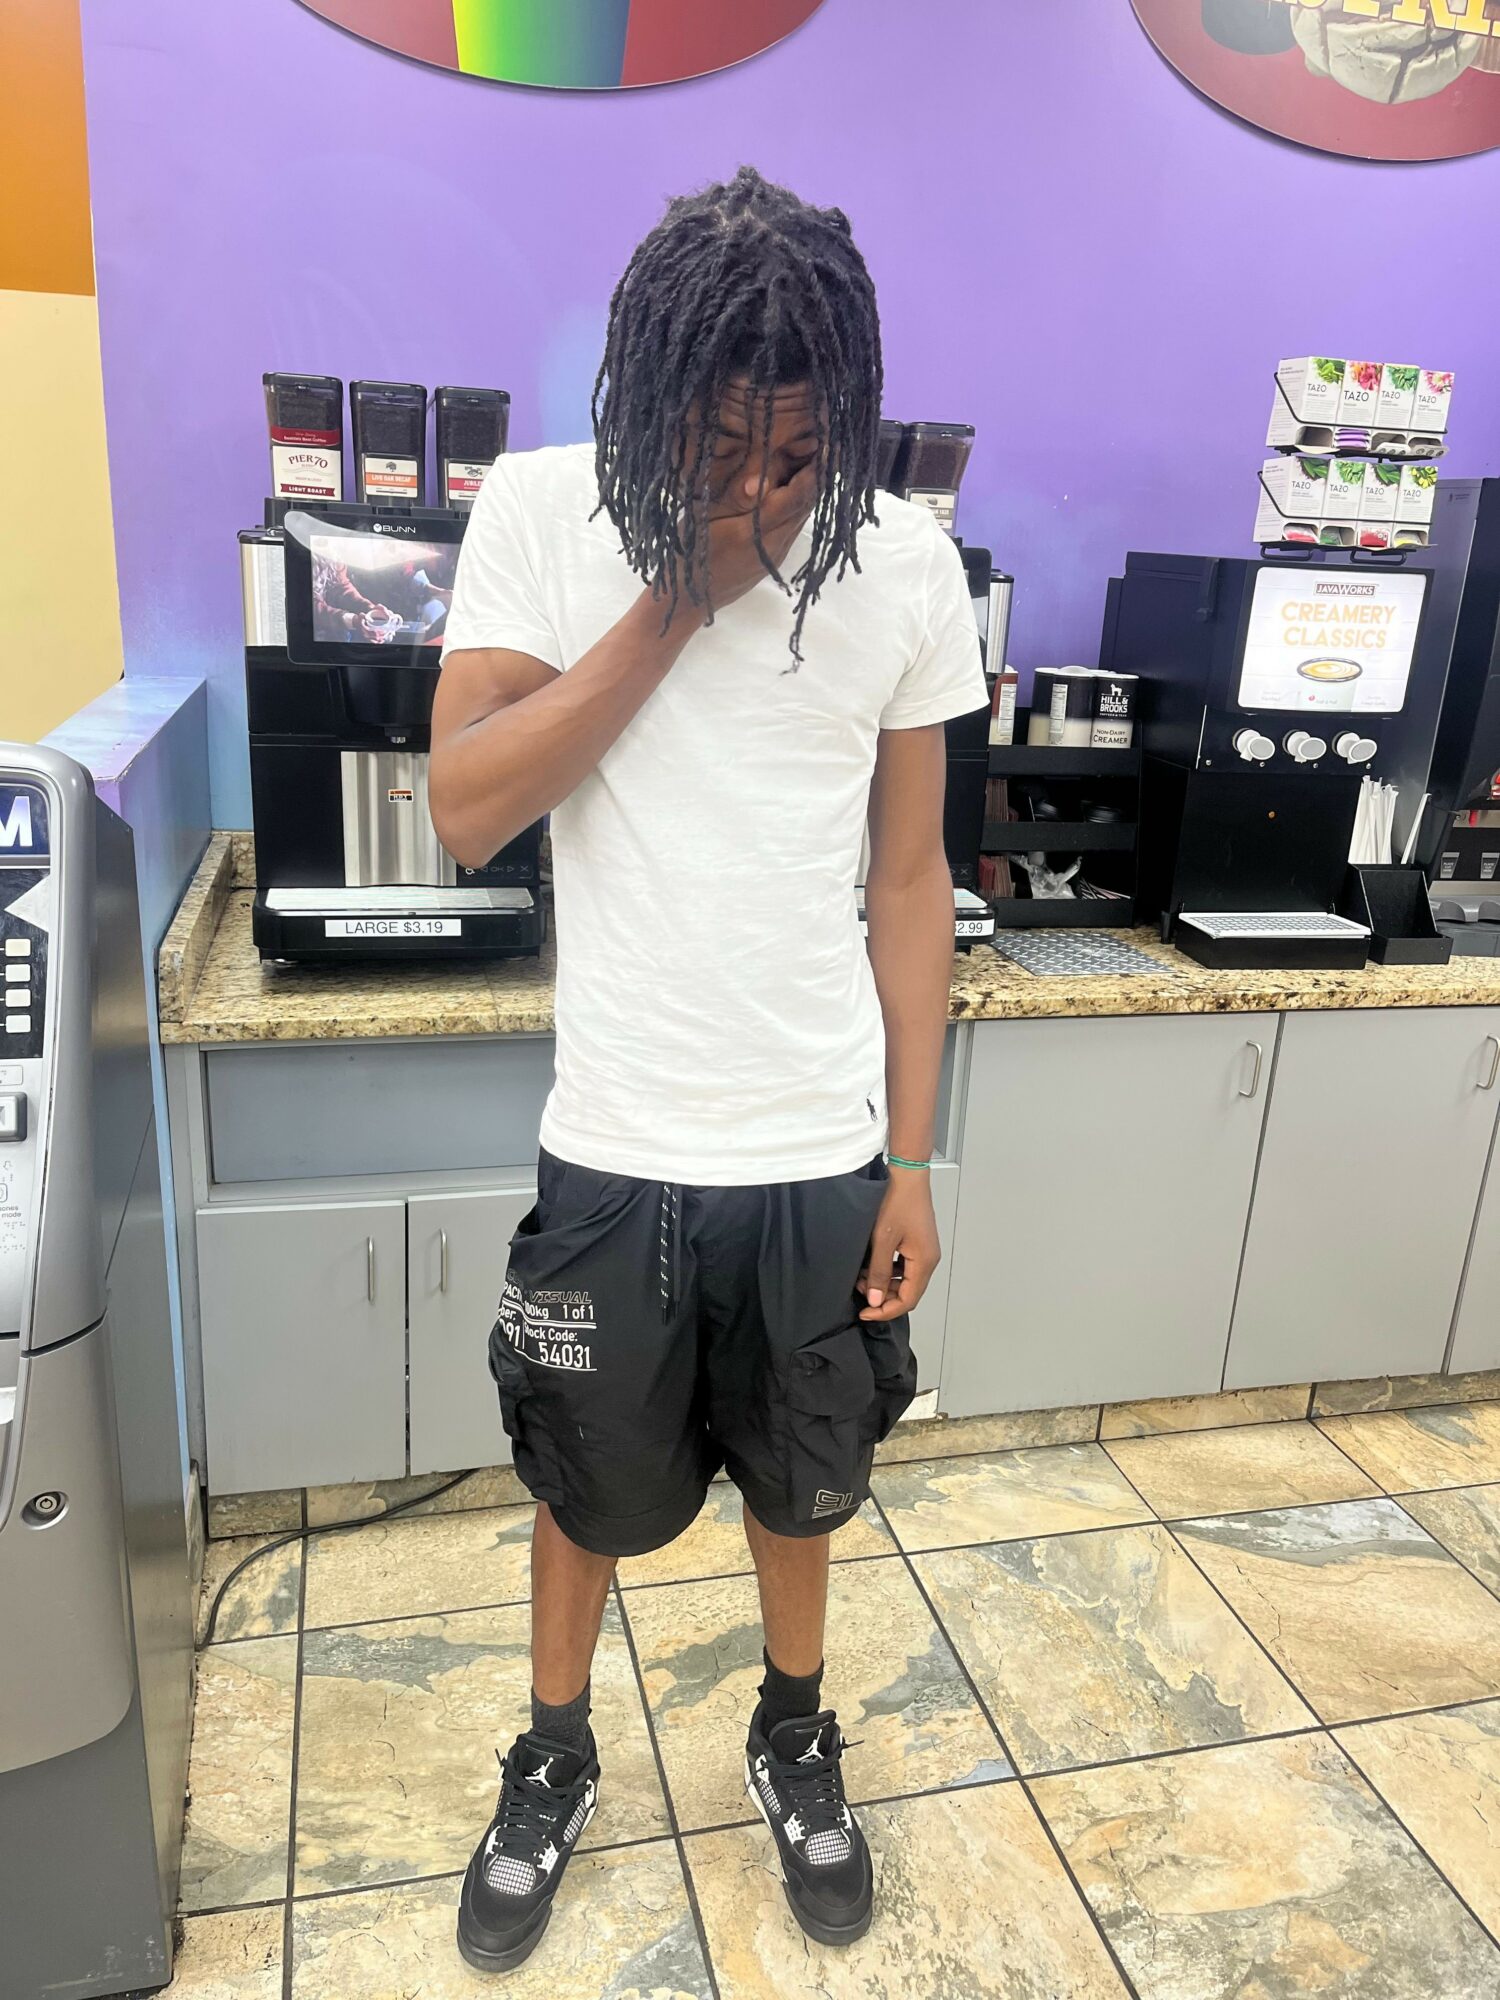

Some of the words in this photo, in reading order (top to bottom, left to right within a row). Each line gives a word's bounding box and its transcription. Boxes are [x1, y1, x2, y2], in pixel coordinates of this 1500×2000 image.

[1307, 383, 1327, 393] TAZO
[1343, 390, 1369, 402] TAZO
[1381, 390, 1400, 400] TAZO
[1418, 394, 1437, 404] TAZO
[288, 454, 314, 465] PIER
[314, 456, 328, 469] 70
[1291, 480, 1312, 490] TAZO
[1329, 484, 1349, 493] TAZO
[1365, 486, 1384, 496] TAZO
[1402, 489, 1421, 498] TAZO
[382, 525, 416, 534] BUNN
[1281, 601, 1397, 625] CREAMERY
[1283, 626, 1387, 649] CLASSICS
[1100, 695, 1121, 705] HILL
[1099, 703, 1128, 713] BROOKS
[0, 796, 33, 847] M
[345, 921, 398, 935] LARGE
[403, 921, 443, 935] $3.19
[530, 1290, 592, 1304] VISUAL
[571, 1304, 586, 1320] of
[588, 1304, 594, 1320] 1
[548, 1327, 578, 1342] Code:
[538, 1341, 591, 1369] 54031
